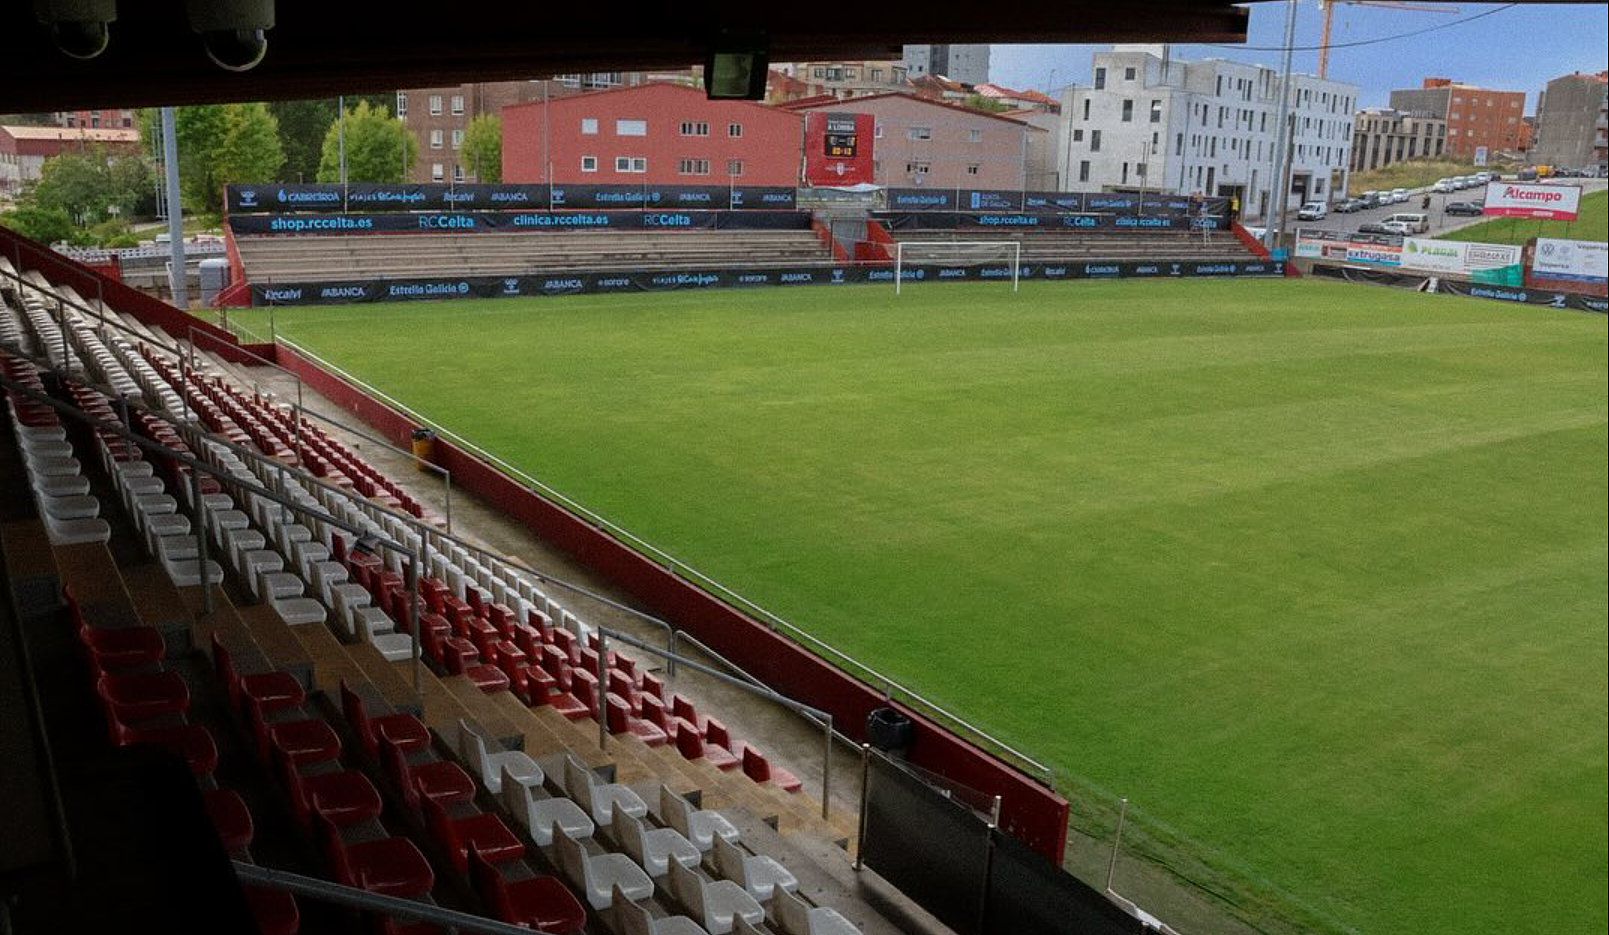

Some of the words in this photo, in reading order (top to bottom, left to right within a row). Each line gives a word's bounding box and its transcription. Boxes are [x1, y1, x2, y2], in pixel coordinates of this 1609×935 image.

[491, 192, 528, 201] ABANCA
[1503, 186, 1562, 202] Alcampo
[271, 217, 373, 231] shop.rccelta.es
[419, 214, 475, 228] RCCelta
[514, 213, 609, 226] clinica.rccelta.es
[644, 213, 691, 226] RCCelta
[781, 272, 813, 282] ABANCA
[389, 284, 424, 296] Estrella
[425, 283, 457, 294] Galicia
[545, 279, 583, 289] ABANCA
[321, 286, 366, 298] ABANCA
